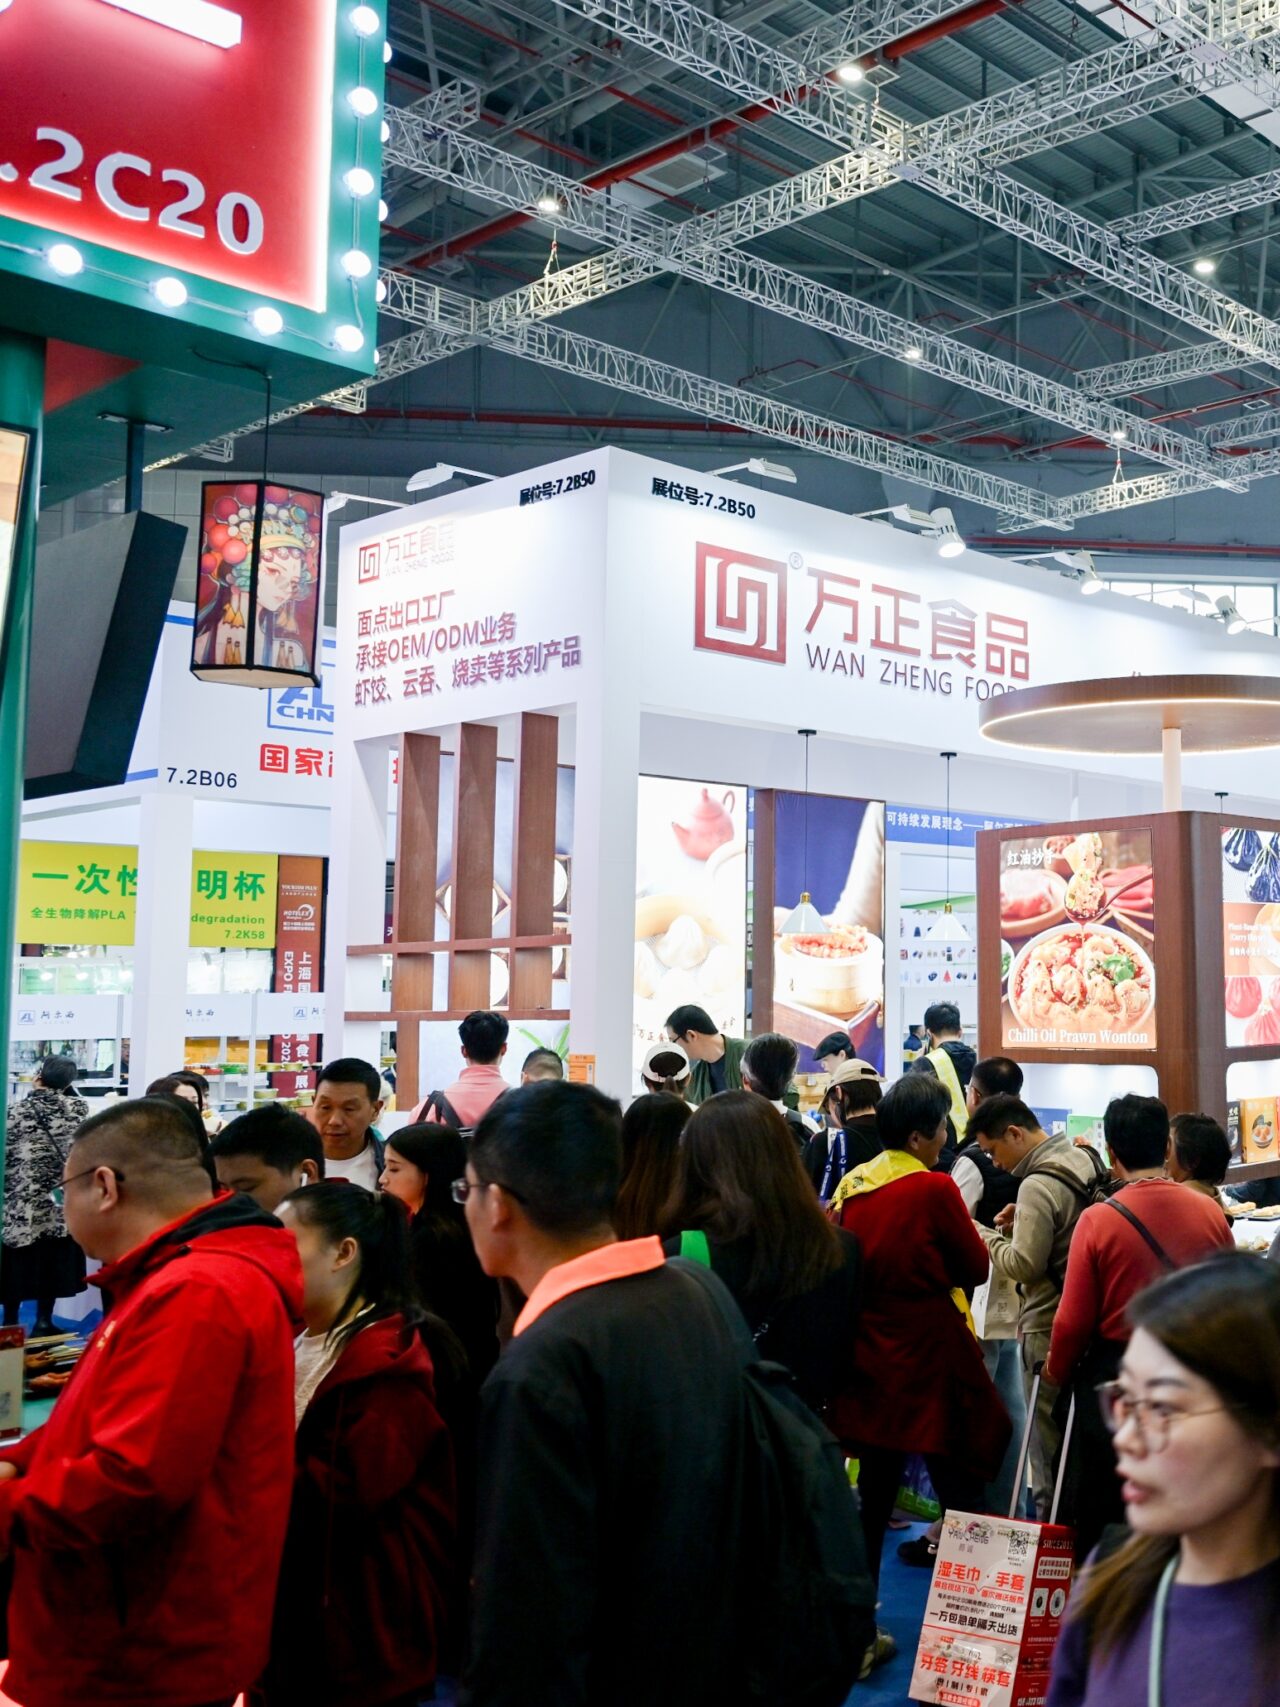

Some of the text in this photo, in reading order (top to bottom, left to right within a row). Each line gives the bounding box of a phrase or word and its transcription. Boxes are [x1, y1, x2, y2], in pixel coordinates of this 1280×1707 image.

[652, 477, 756, 519] 展位号:7.2B50
[357, 589, 455, 638] 面点出口工厂
[355, 611, 517, 672] 承接OEM/ODM业务
[354, 635, 581, 707] 虾饺、云吞、烧卖等系列产品
[805, 643, 865, 678] WAN
[879, 658, 953, 696] ZHENG
[259, 743, 333, 778] 国家
[167, 767, 238, 789] 7.2B06
[1006, 849, 1055, 866] 红油抄手
[31, 907, 126, 921] 全生物降解PLA
[191, 913, 265, 926] degradation
[224, 930, 265, 939] 7.2K58
[283, 951, 294, 981] EXPO
[1007, 1028, 1148, 1044] Chilli Oil Prawn Wonton
[938, 1561, 981, 1582] 湿毛巾
[996, 1571, 1026, 1591] 手套
[930, 1609, 1018, 1637] 一万包急单隔天出货
[920, 1652, 949, 1675] 牙签
